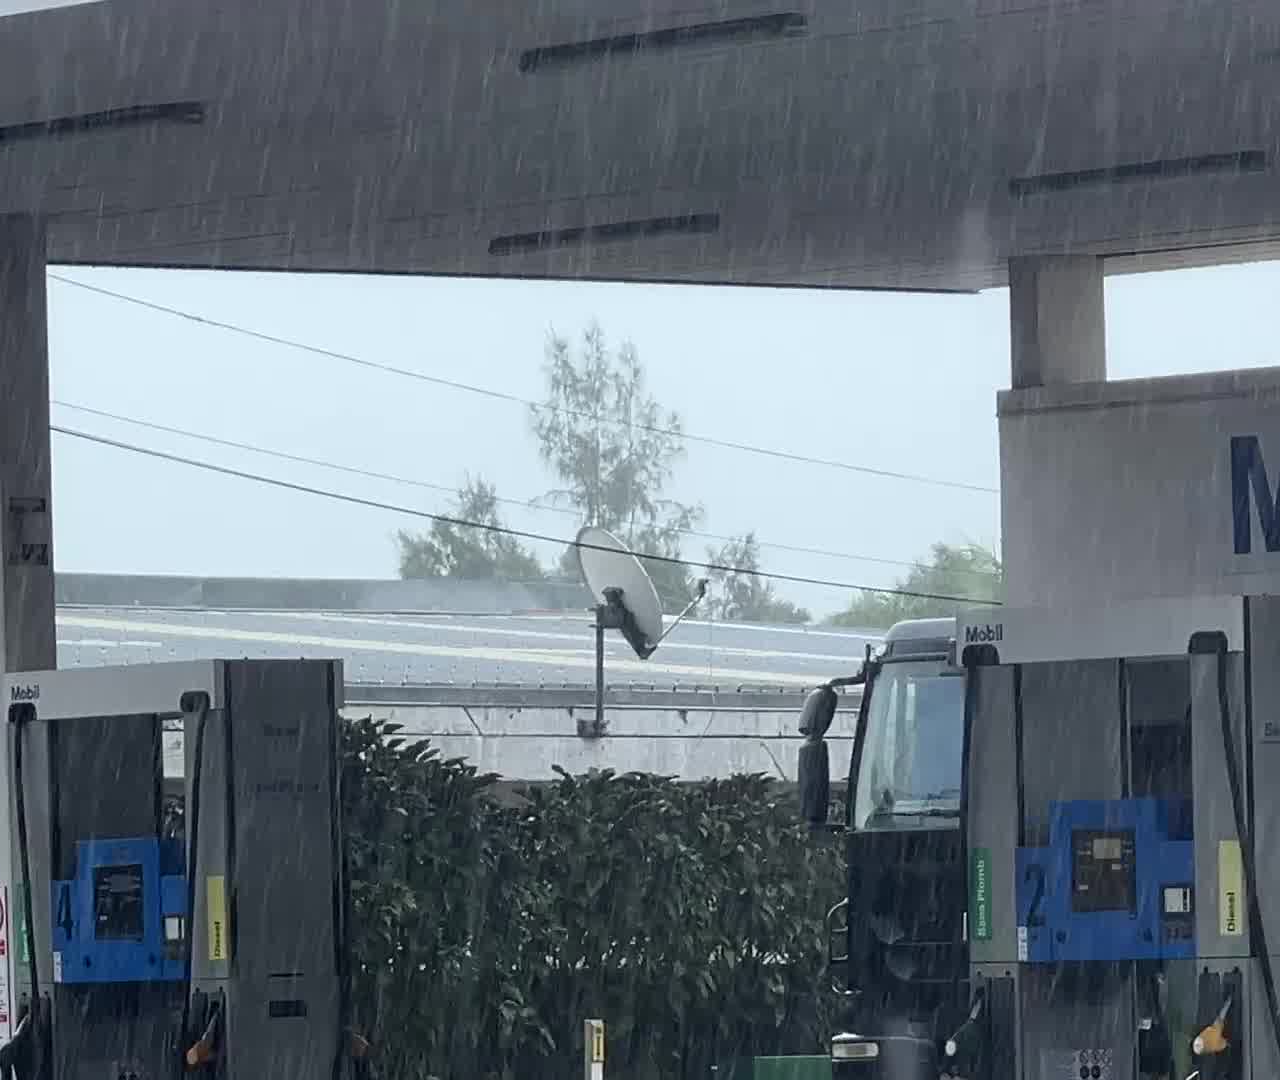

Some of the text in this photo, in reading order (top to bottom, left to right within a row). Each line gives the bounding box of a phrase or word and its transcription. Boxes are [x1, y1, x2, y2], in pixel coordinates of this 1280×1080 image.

[966, 624, 1003, 642] Mobil
[11, 684, 40, 700] Mobil
[57, 884, 75, 942] 4
[1025, 864, 1047, 926] 2
[1226, 891, 1236, 932] Diesel
